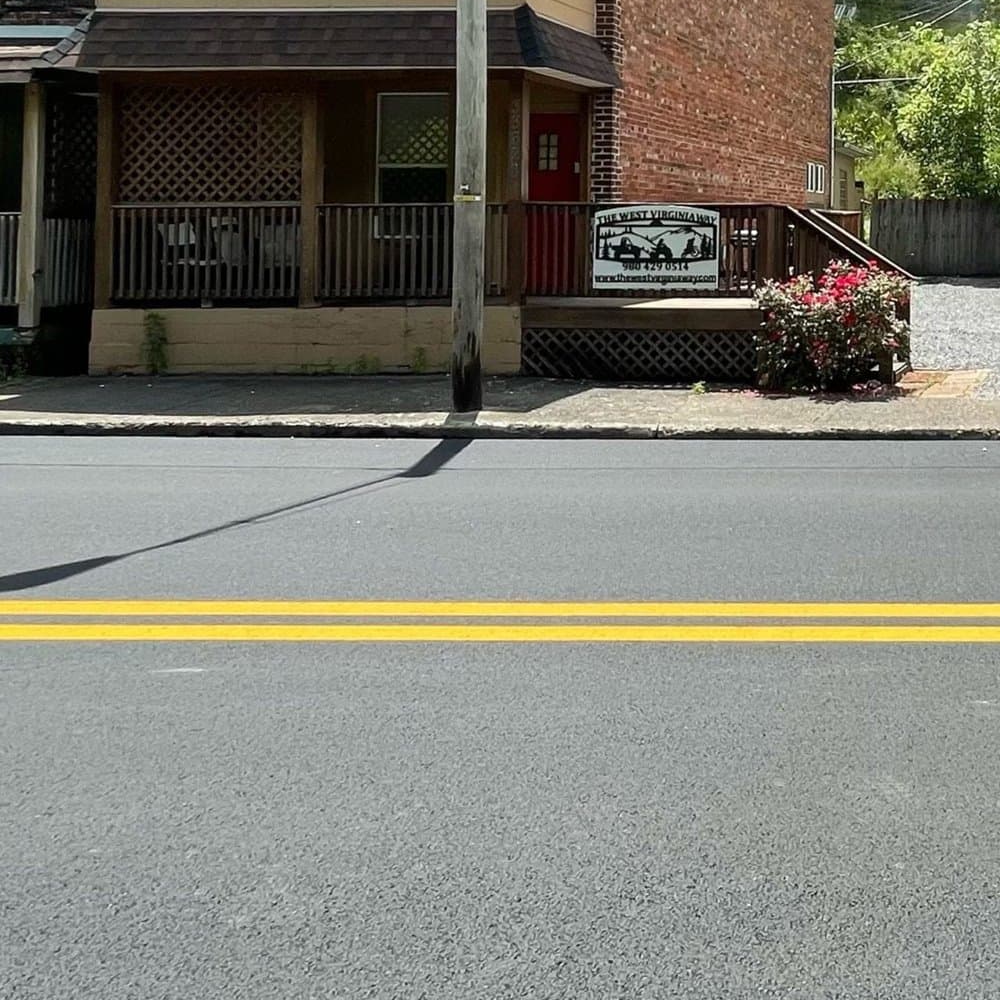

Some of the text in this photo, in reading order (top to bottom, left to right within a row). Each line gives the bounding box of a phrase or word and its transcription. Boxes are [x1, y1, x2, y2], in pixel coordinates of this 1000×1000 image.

[597, 210, 717, 225] THE WEST VIRGINIA WAY
[644, 262, 662, 271] 429
[665, 262, 689, 271] 0514
